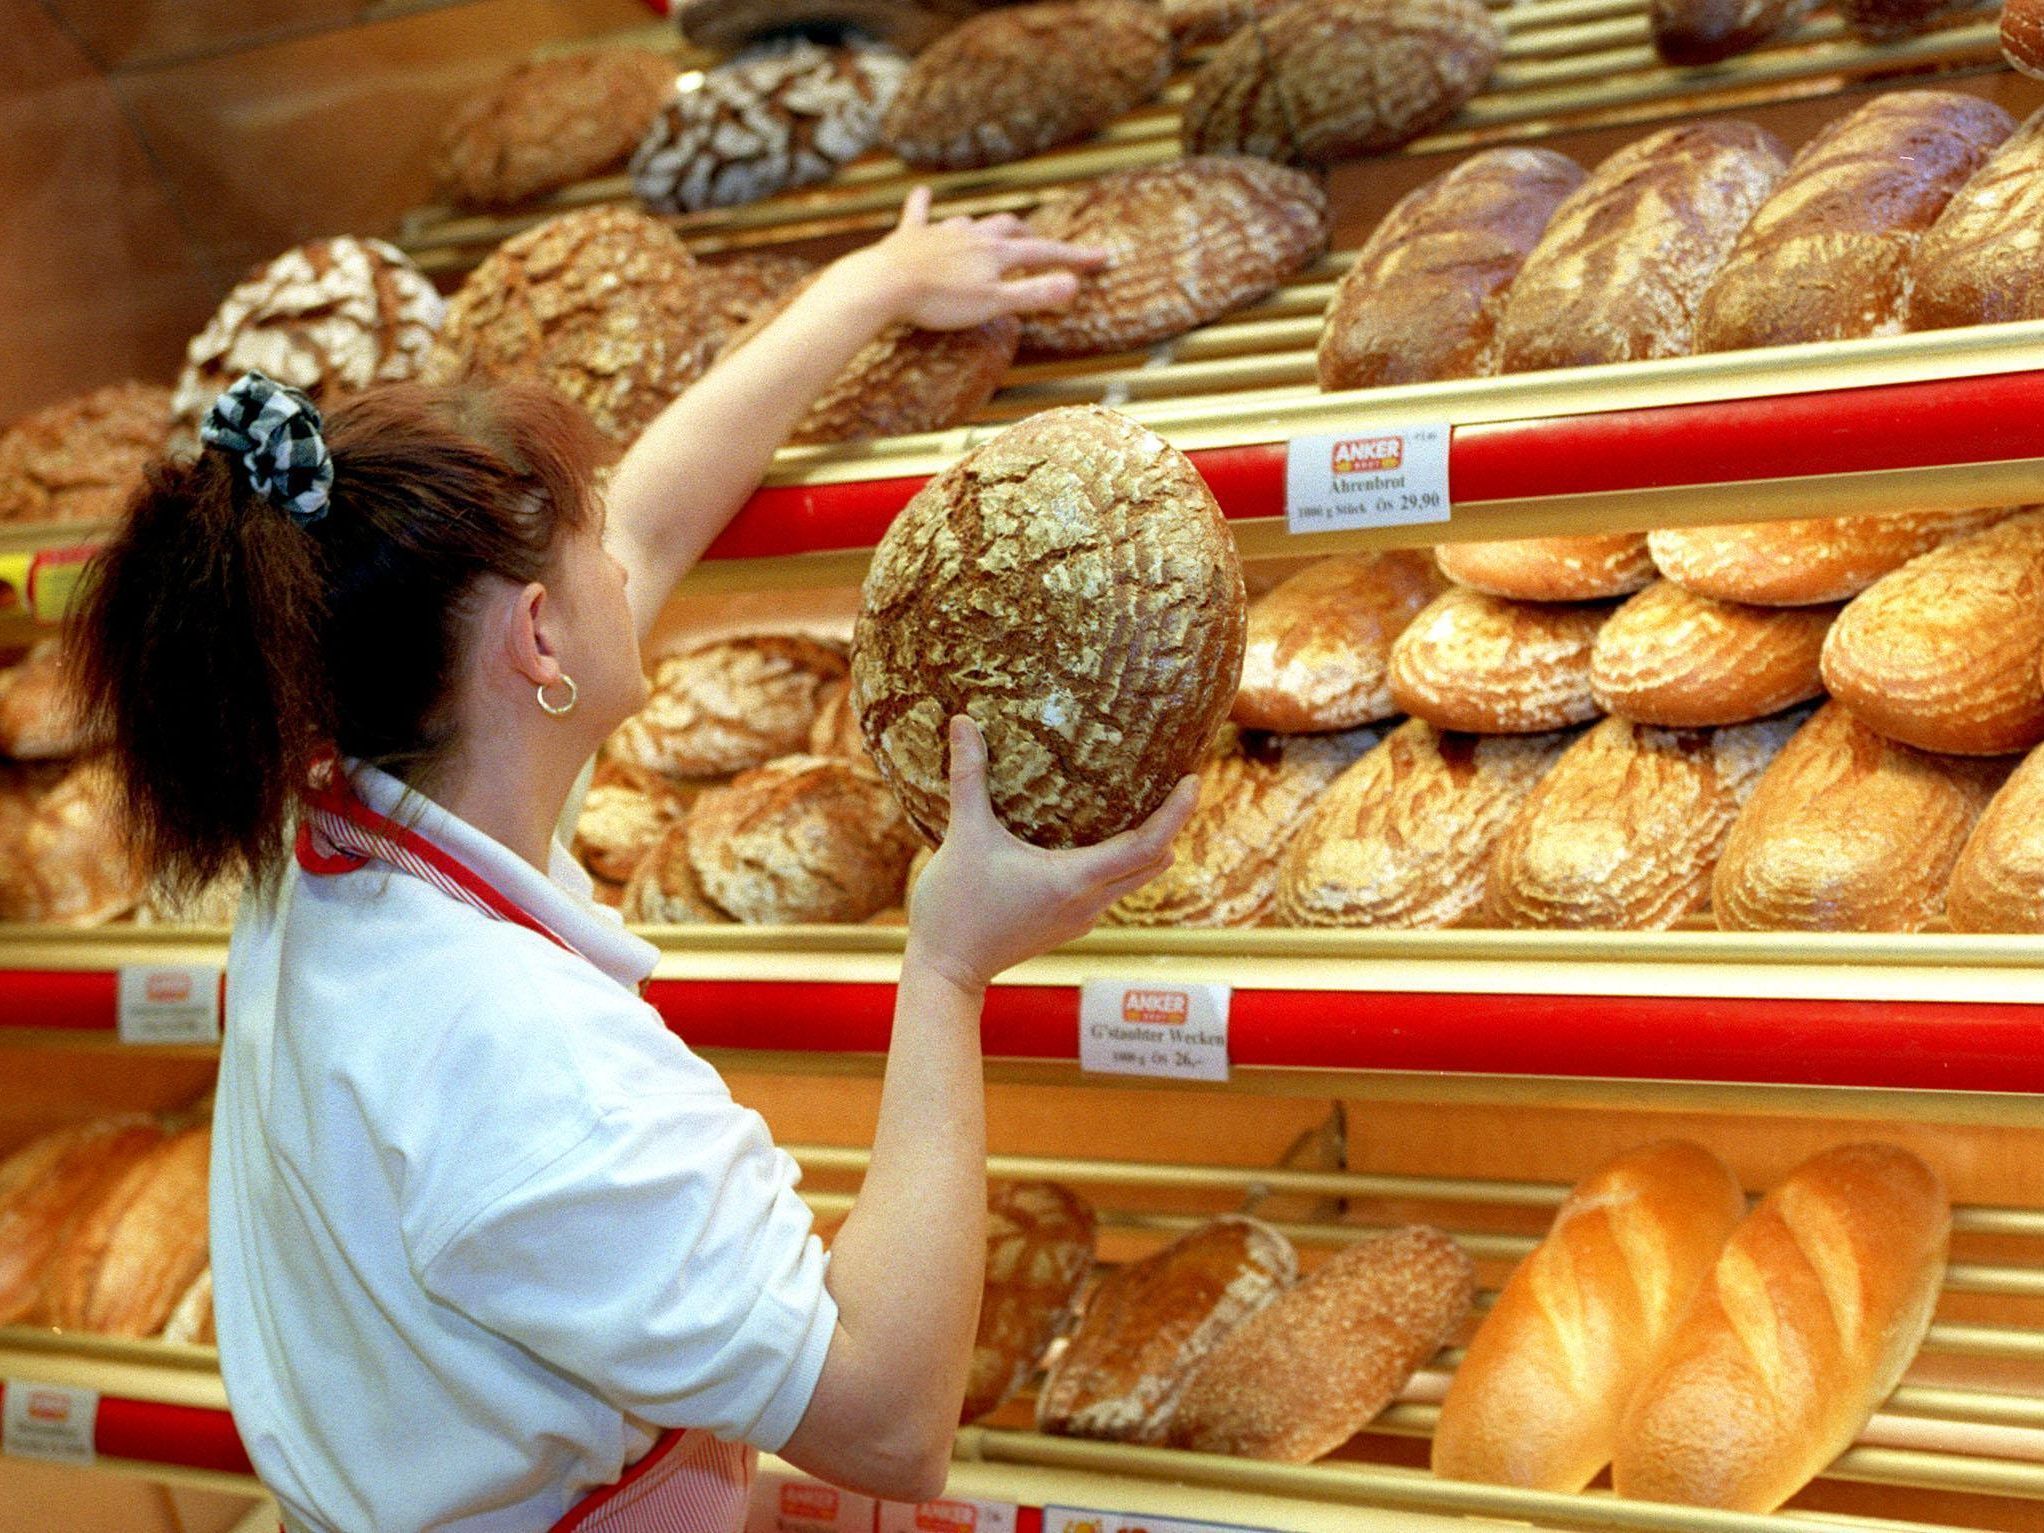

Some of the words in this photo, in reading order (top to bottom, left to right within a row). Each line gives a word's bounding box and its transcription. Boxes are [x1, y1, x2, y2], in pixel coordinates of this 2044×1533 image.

[1335, 440, 1401, 463] ANKER
[1401, 491, 1439, 510] 29,90
[1126, 993, 1185, 1013] ANKER
[1170, 1029, 1225, 1046] Wecken
